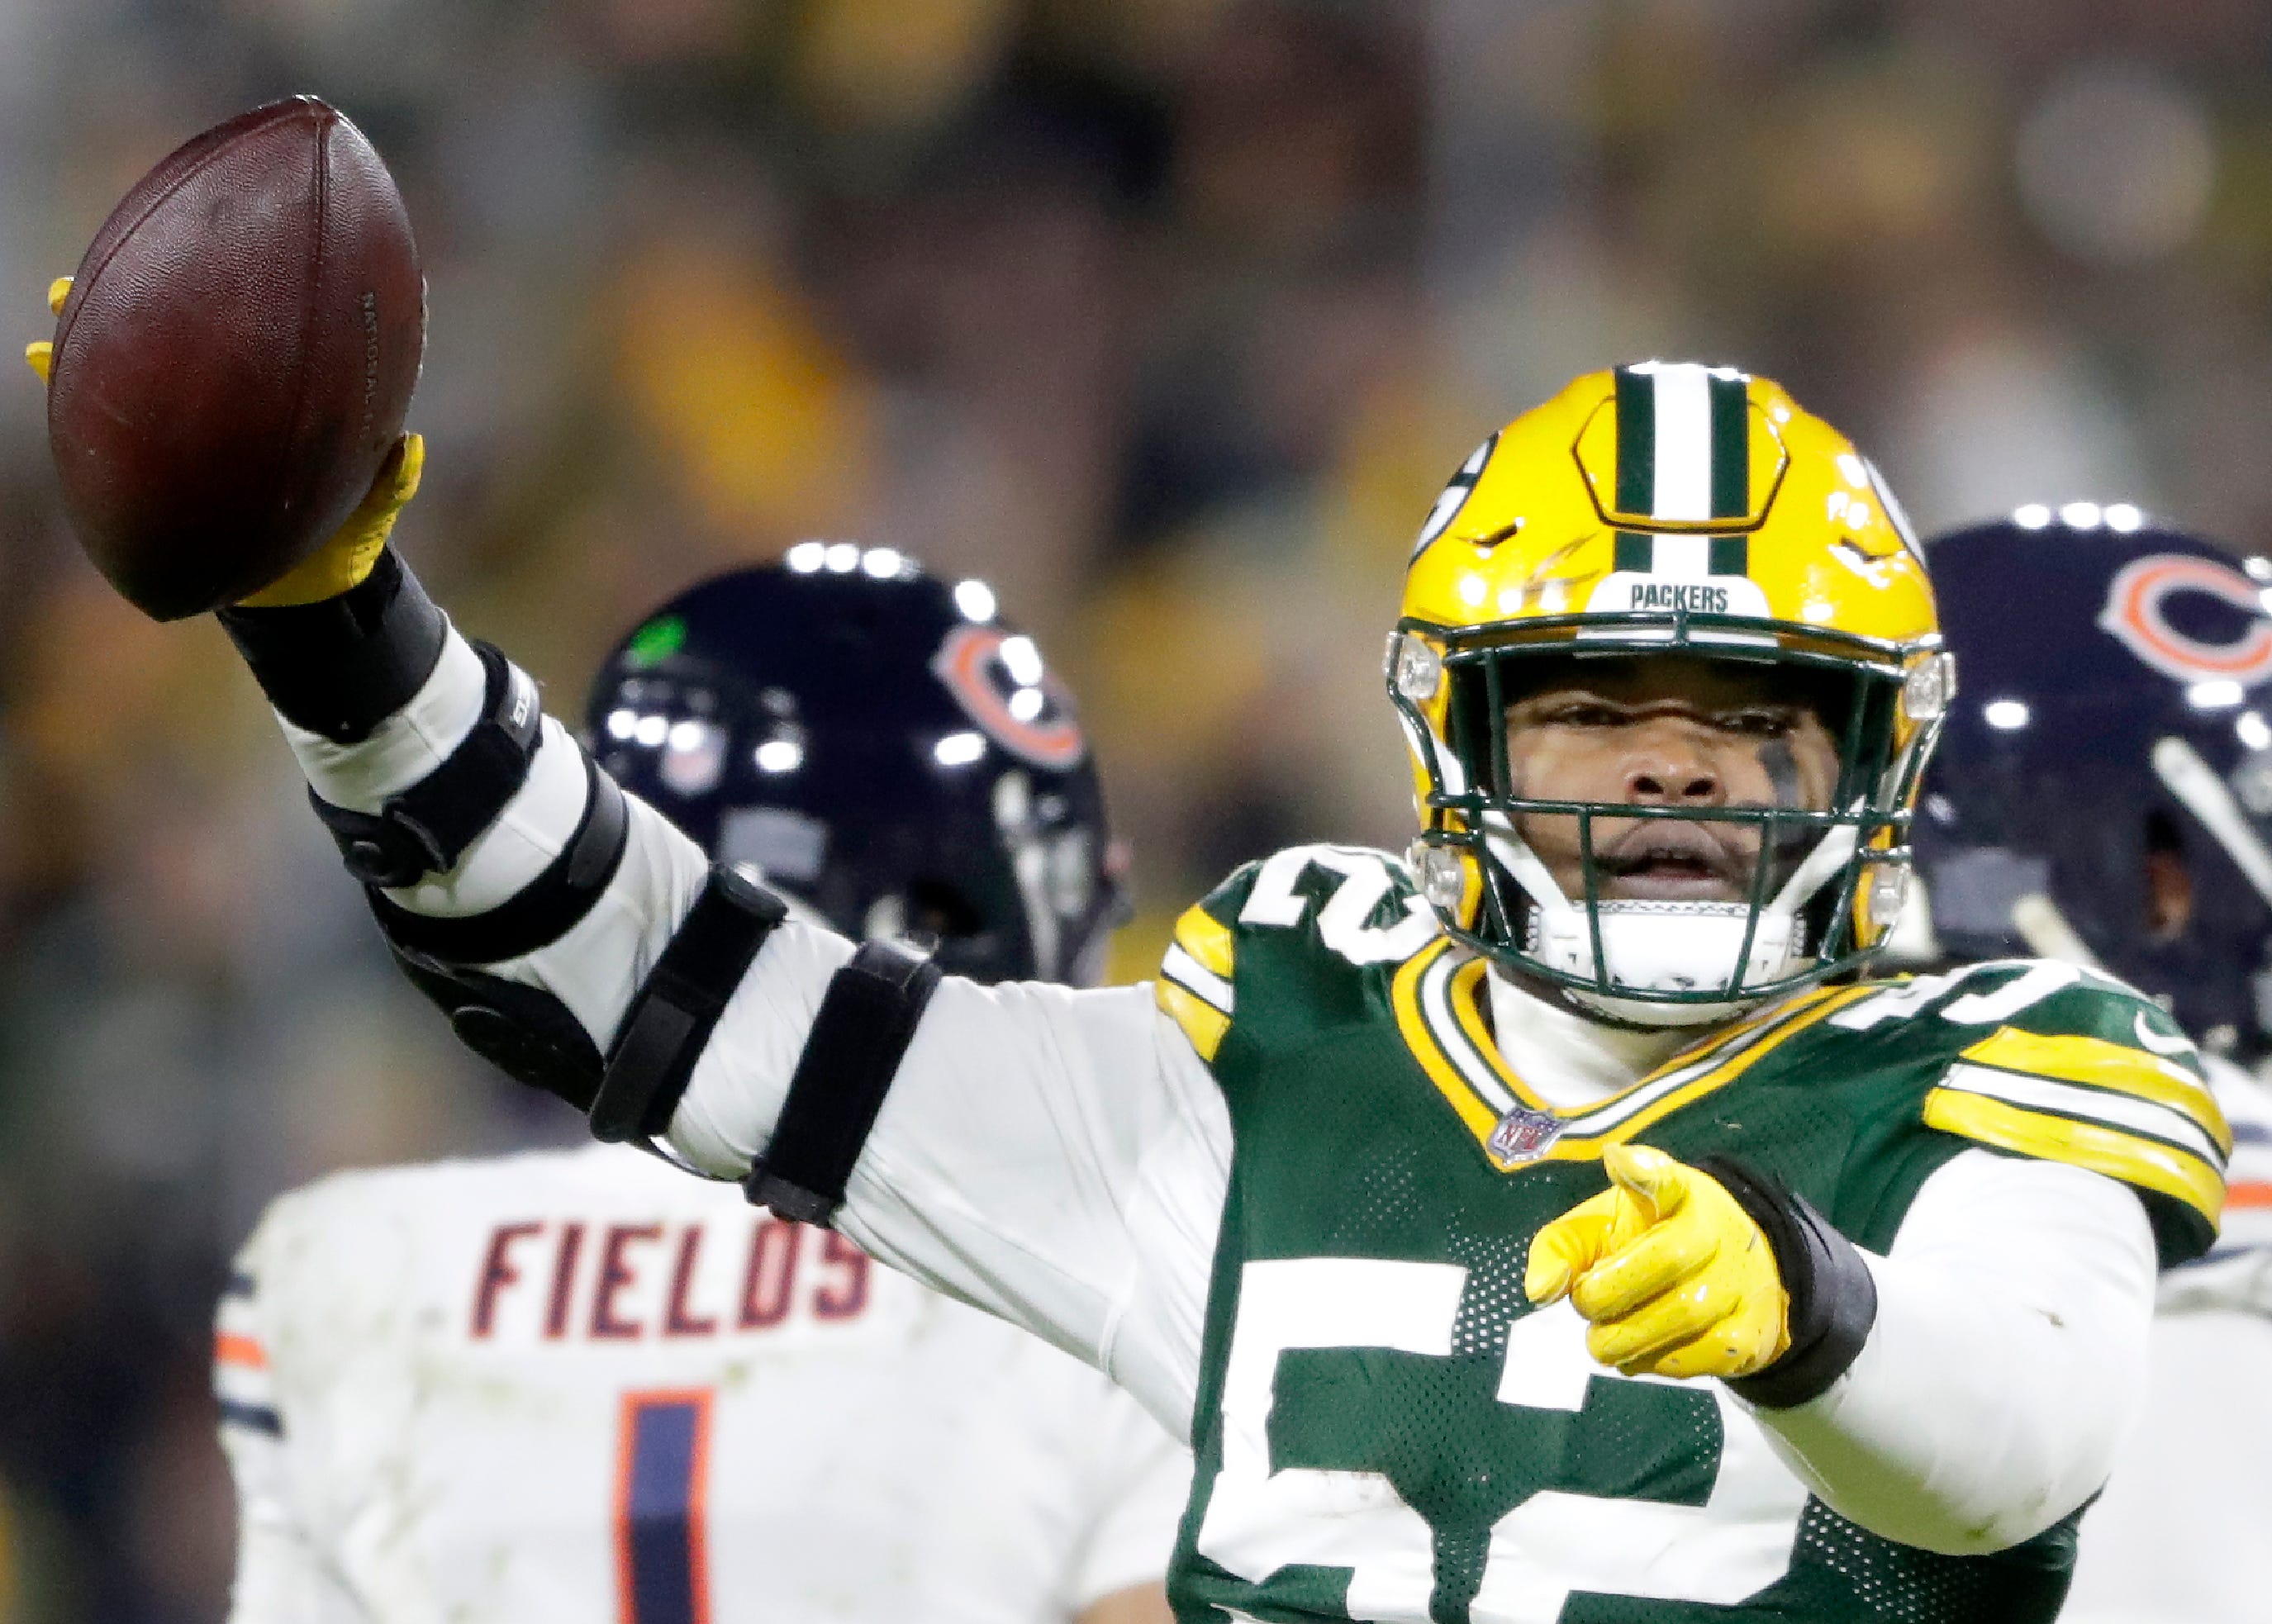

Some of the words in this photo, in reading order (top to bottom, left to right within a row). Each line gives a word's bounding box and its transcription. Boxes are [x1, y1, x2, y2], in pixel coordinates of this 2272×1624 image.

[1630, 583, 1729, 614] PACKERS
[468, 1220, 872, 1339] FIELDS
[611, 1387, 717, 1624] 1
[1198, 1257, 1811, 1624] 52
